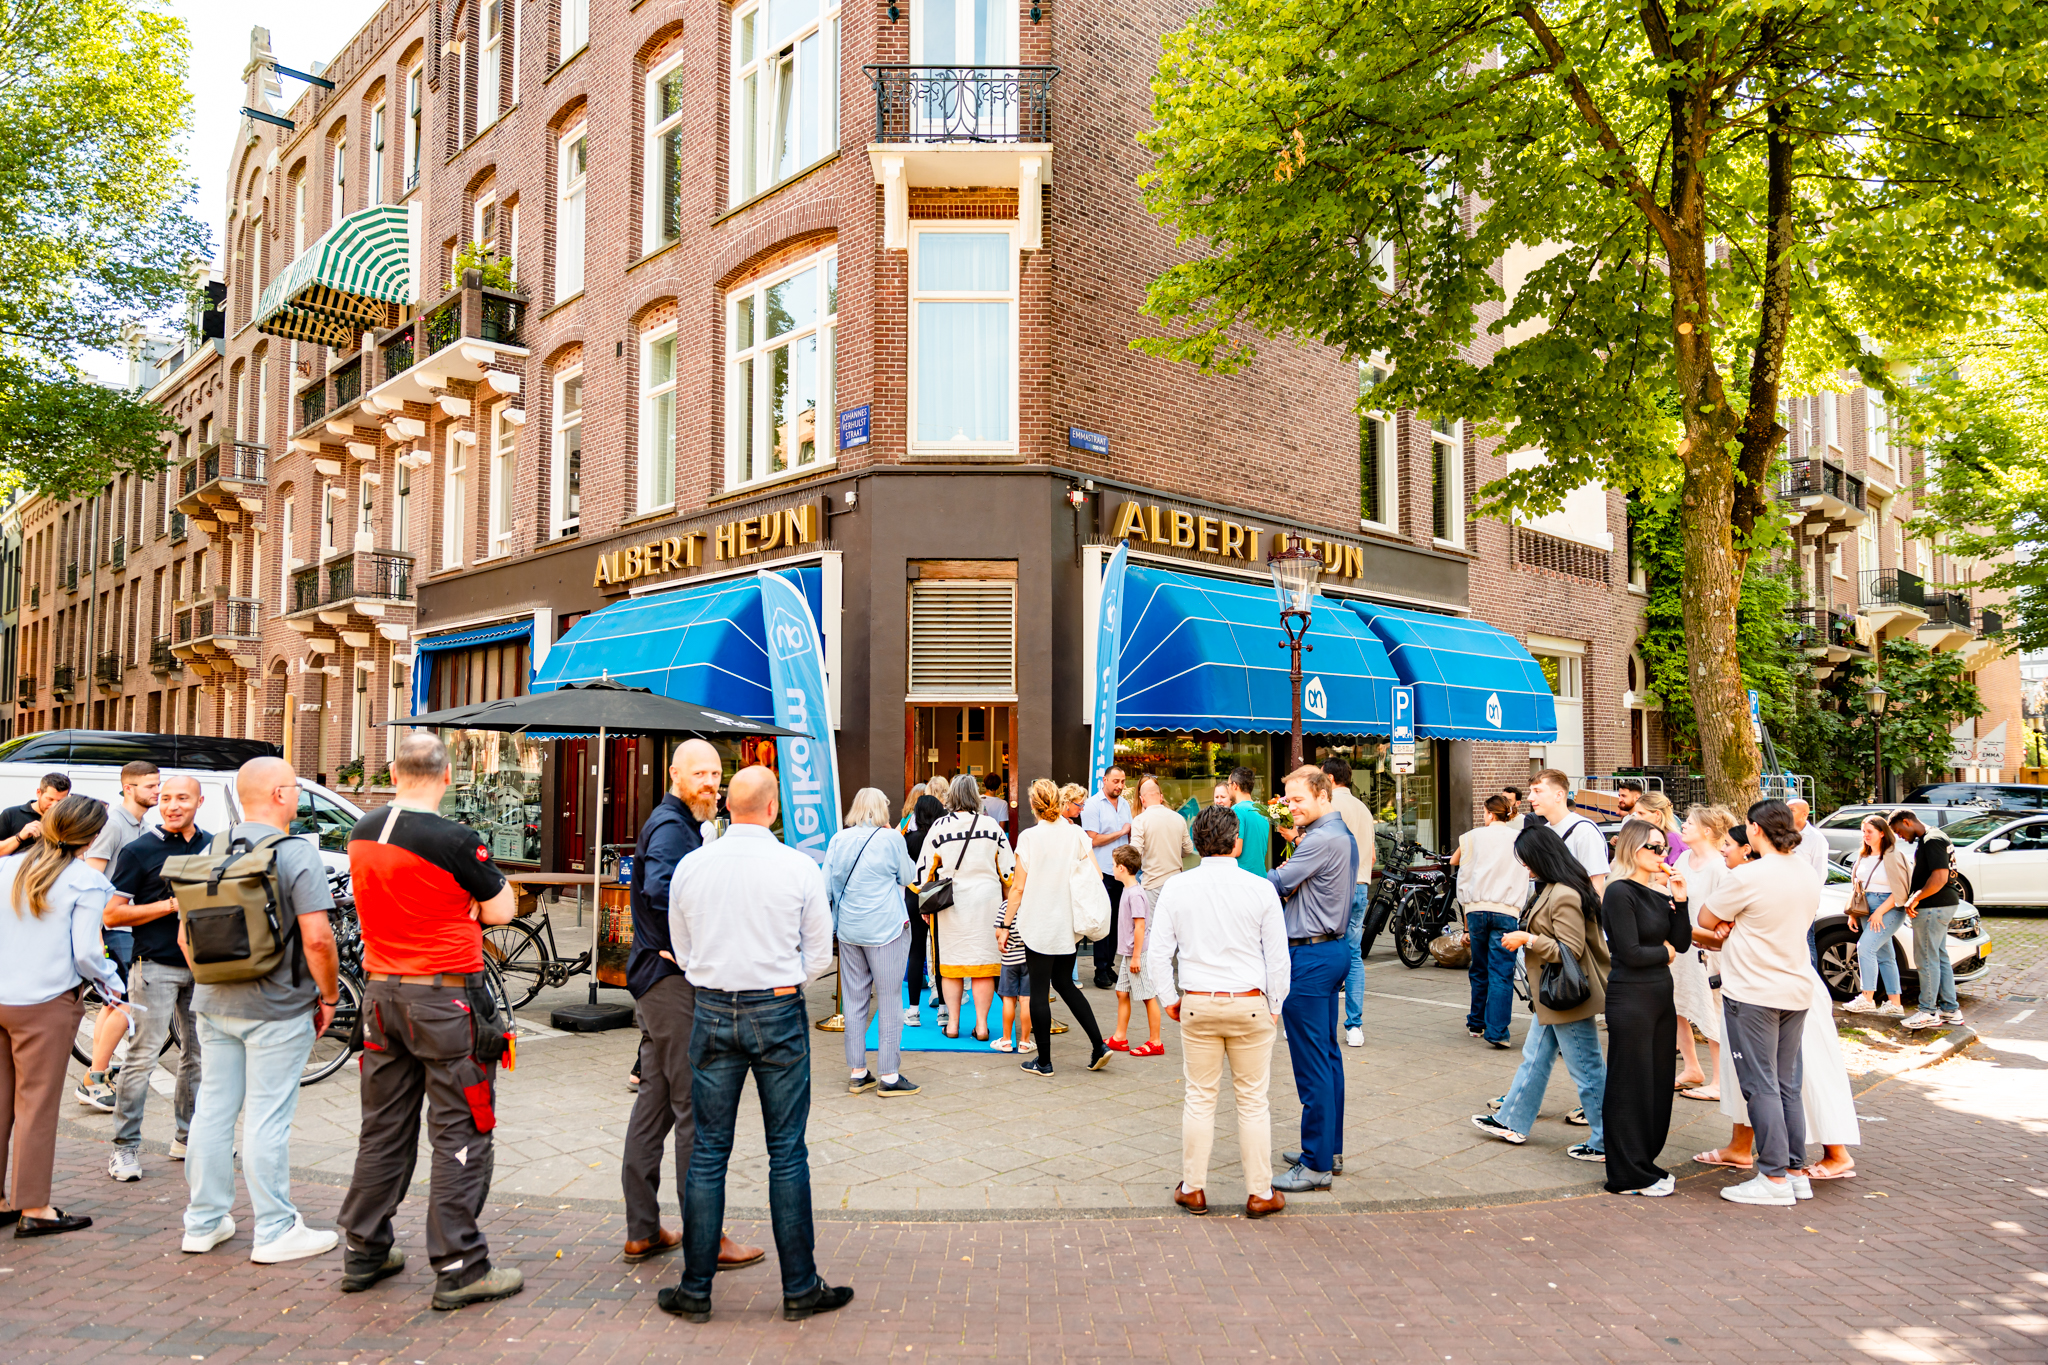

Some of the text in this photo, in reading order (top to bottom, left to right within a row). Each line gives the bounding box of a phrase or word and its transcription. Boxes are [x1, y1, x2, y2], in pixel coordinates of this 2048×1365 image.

[842, 408, 867, 425] JOHANNES
[842, 417, 867, 431] VERHULST
[845, 428, 863, 440] STRAAT
[1072, 430, 1106, 446] EMMASTRAAT
[1112, 501, 1264, 562] ALBERT
[593, 530, 707, 588] ALBERT
[1396, 691, 1410, 720] P
[1751, 693, 1757, 710] P
